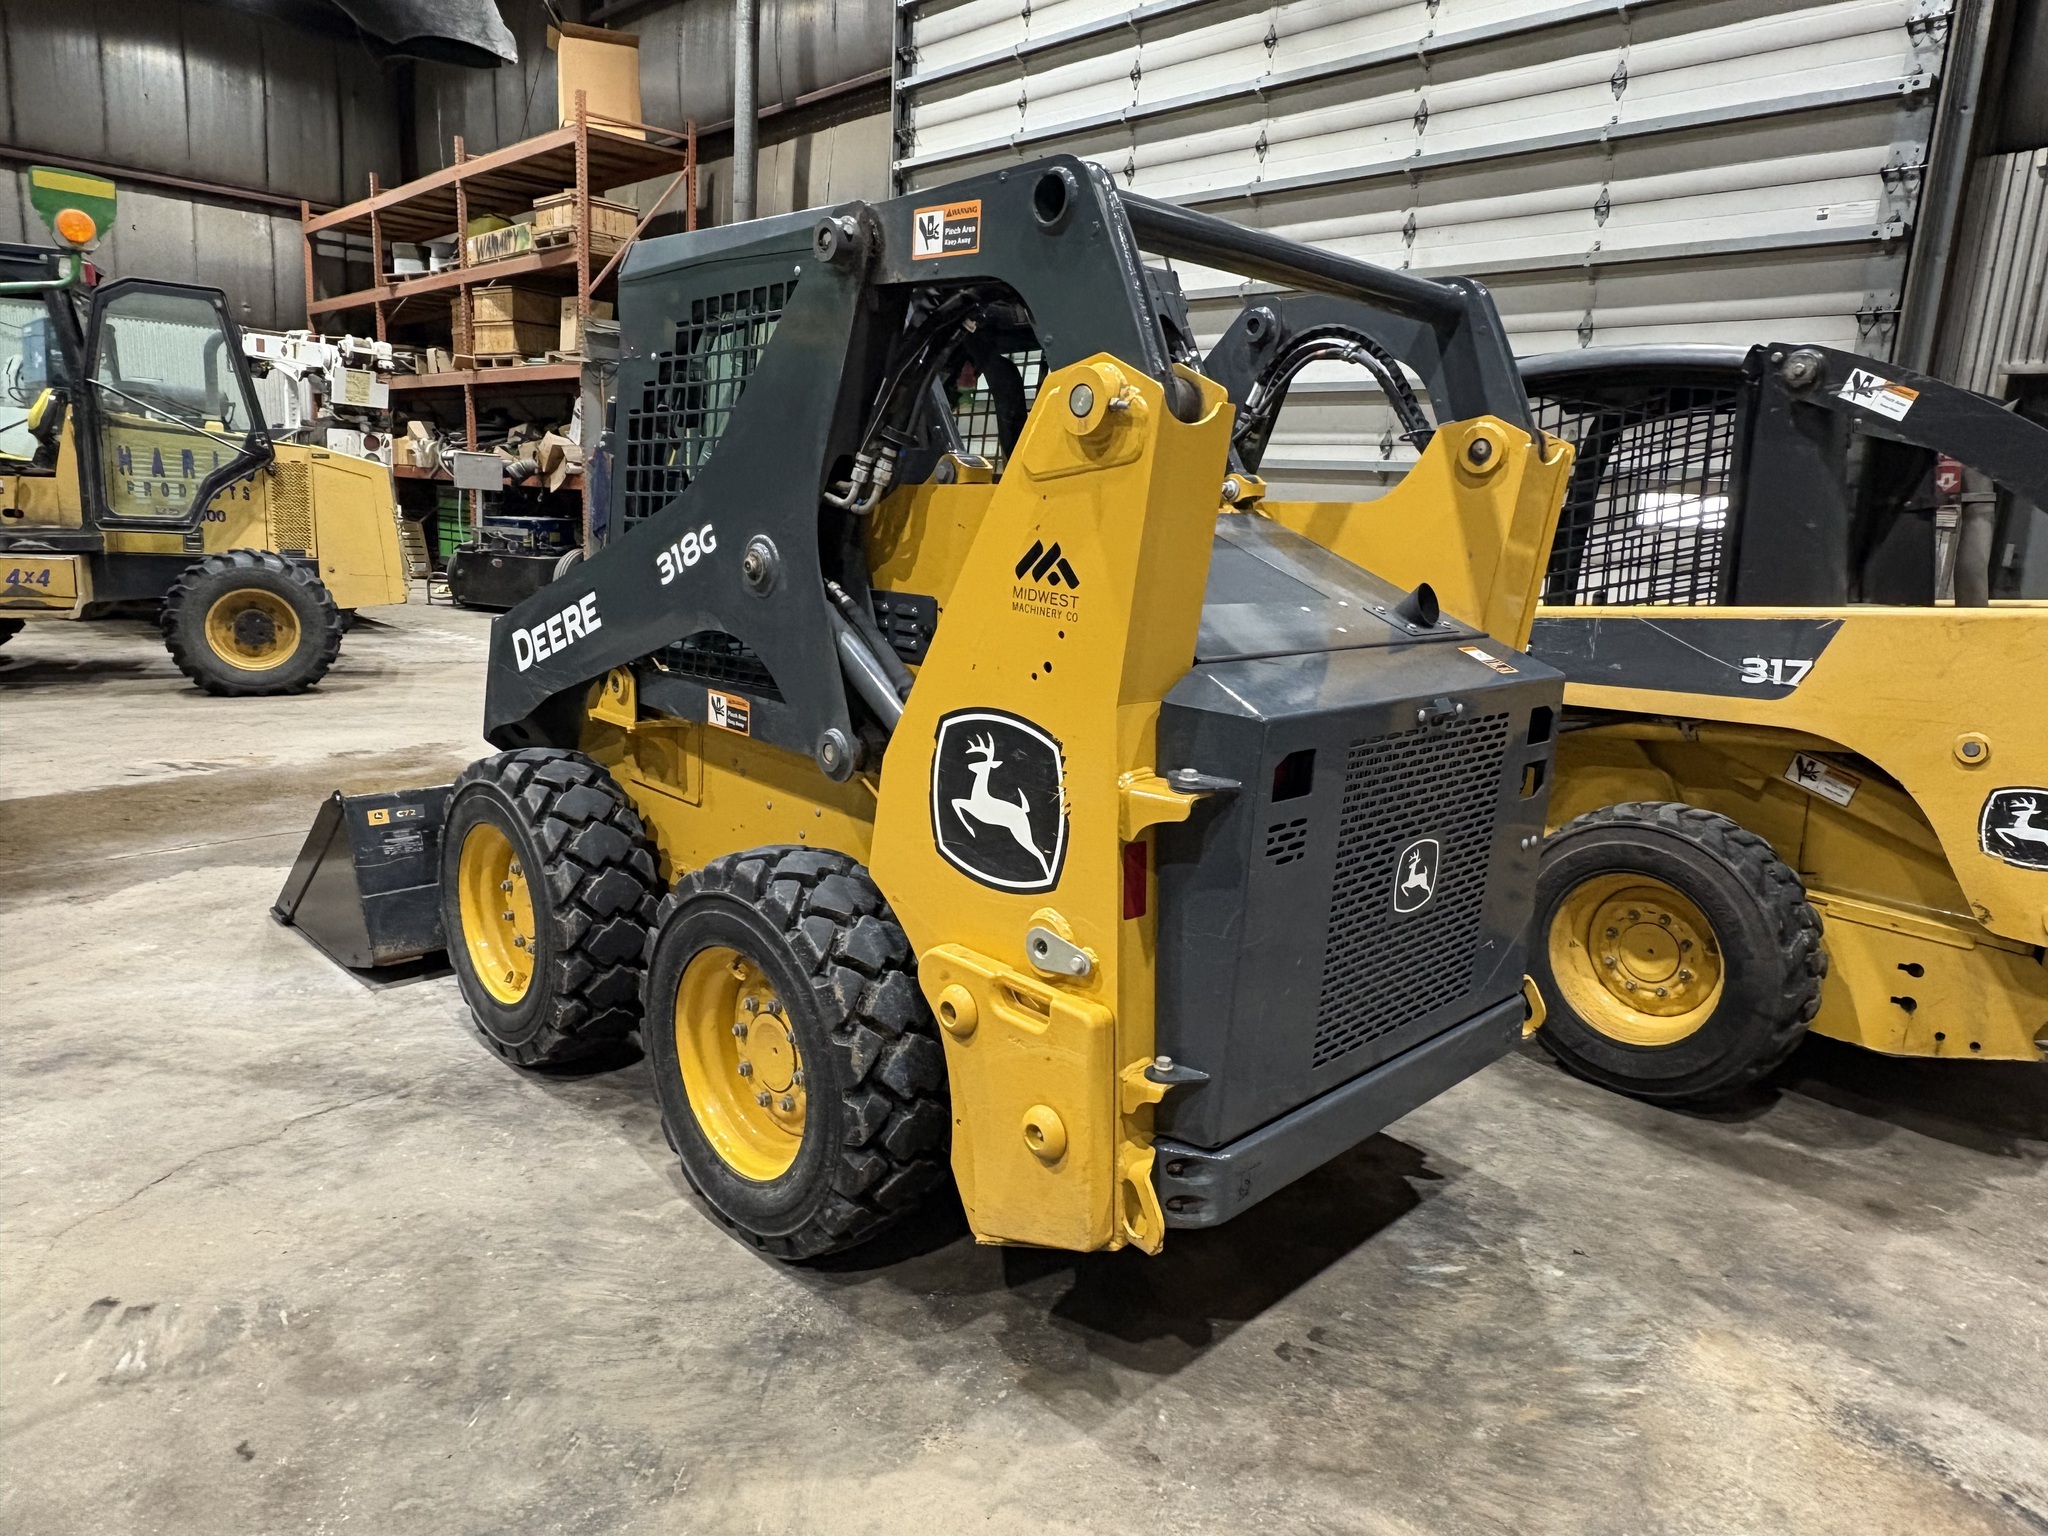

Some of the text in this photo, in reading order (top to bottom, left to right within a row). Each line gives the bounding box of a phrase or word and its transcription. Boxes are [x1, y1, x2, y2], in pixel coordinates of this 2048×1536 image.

[118, 445, 256, 482] HAR
[127, 480, 250, 500] PRODTS
[656, 523, 718, 586] 318G
[1012, 585, 1080, 609] MIDWEST
[1012, 601, 1079, 623] MACHINERY CO
[511, 590, 602, 673] DEERE
[1741, 657, 1813, 687] 317
